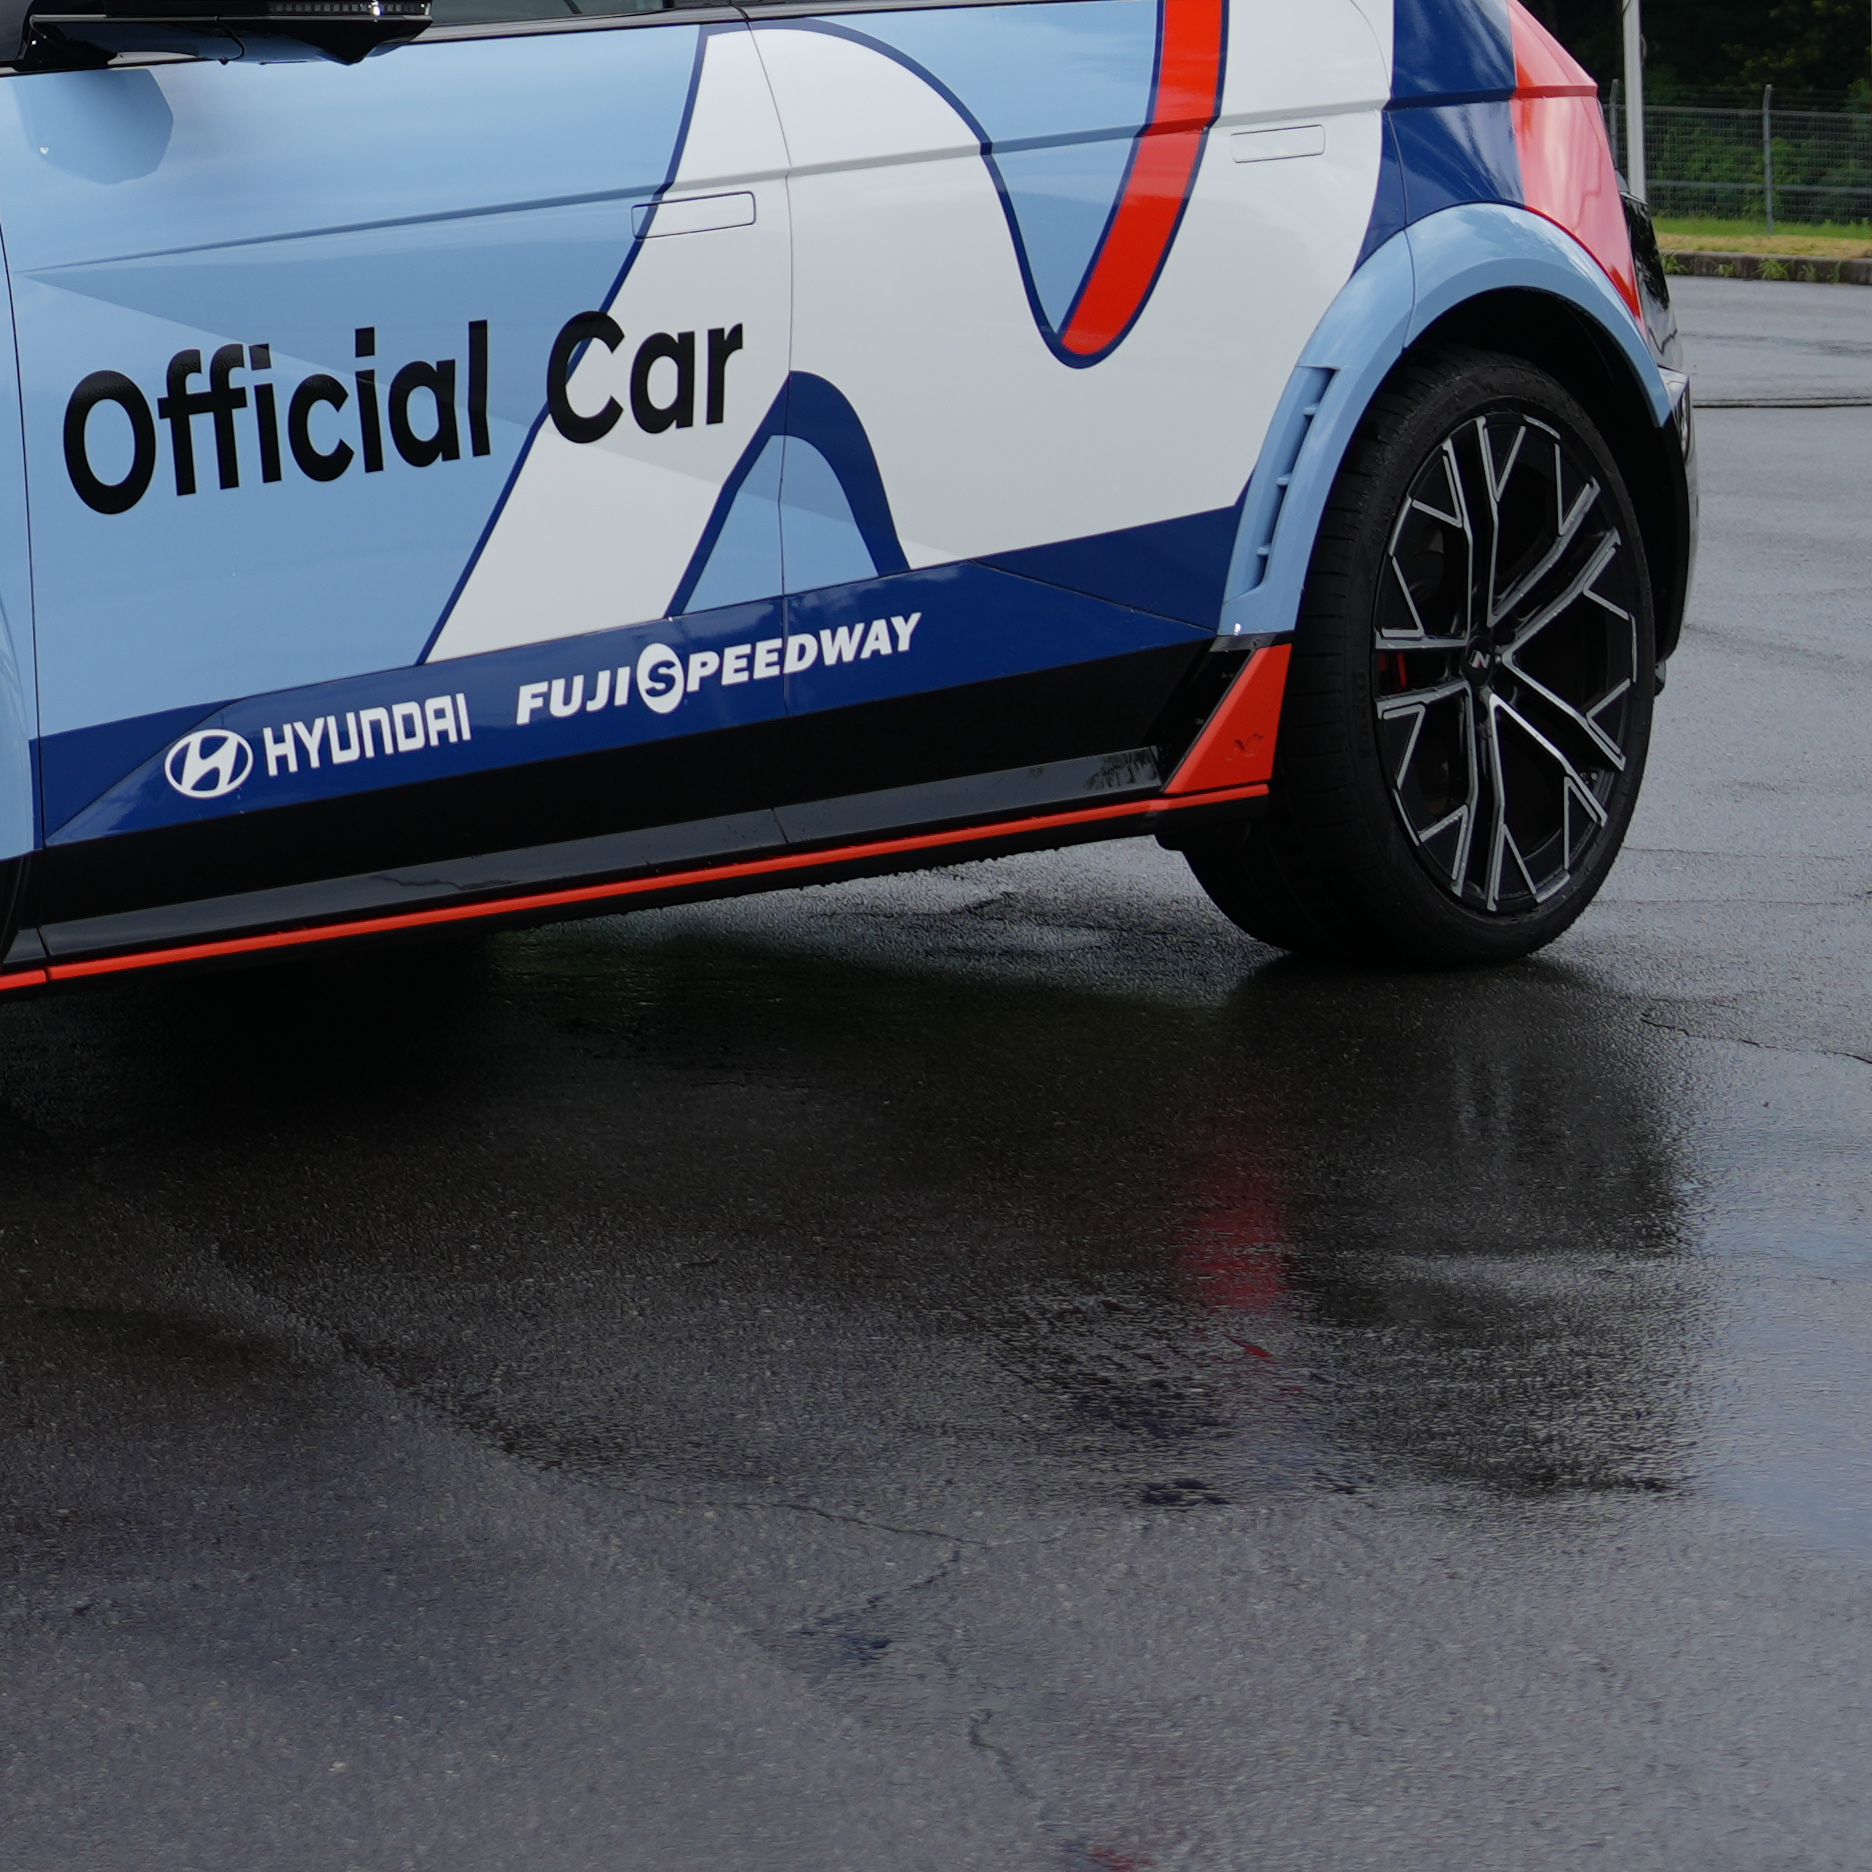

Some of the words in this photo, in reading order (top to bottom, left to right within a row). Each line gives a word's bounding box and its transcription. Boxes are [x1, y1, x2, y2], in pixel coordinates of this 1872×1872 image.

[62, 319, 491, 515] Official
[546, 309, 744, 444] Car
[515, 665, 632, 726] FUJI
[642, 611, 923, 701] SPEEDWAY
[262, 692, 472, 778] HYUNDAI
